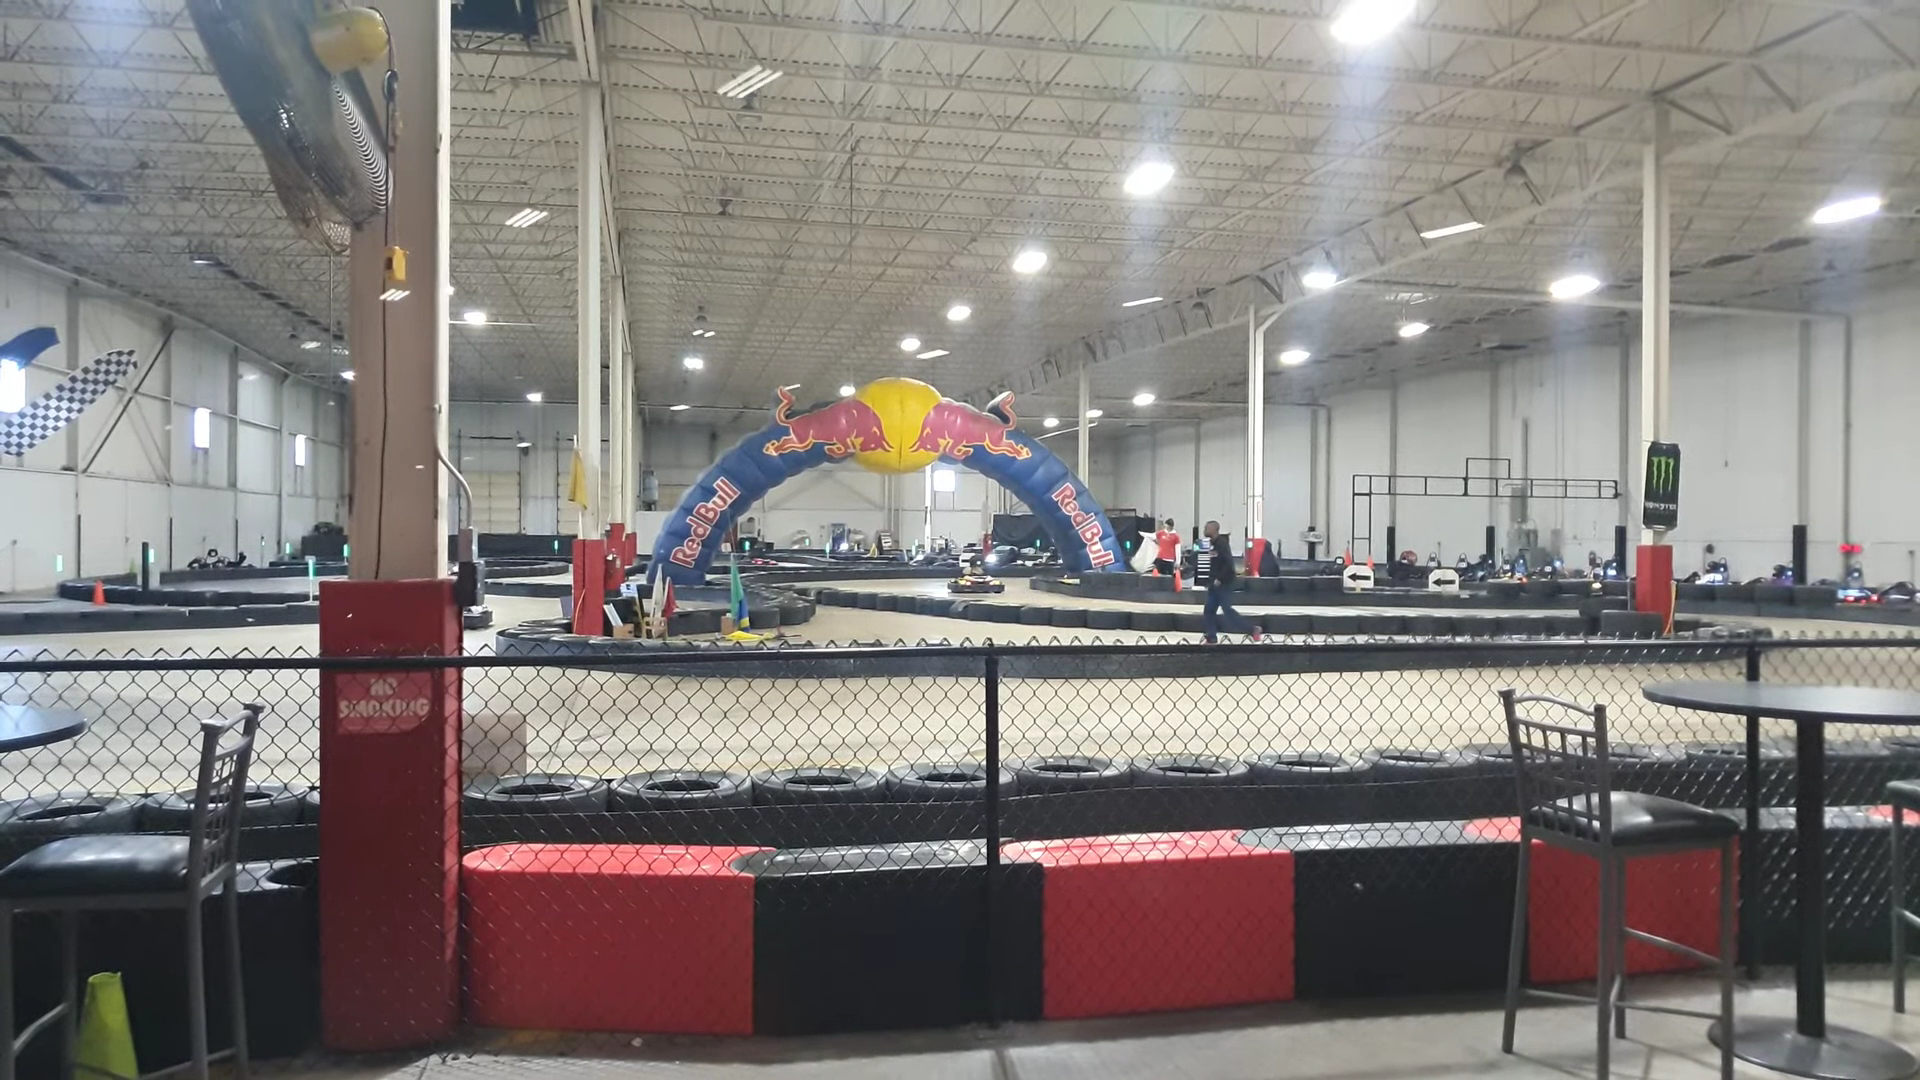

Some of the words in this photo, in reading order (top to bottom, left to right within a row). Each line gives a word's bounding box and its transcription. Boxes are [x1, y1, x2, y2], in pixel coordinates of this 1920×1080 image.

[669, 516, 712, 568] Red
[693, 476, 741, 526] Bull
[1051, 482, 1096, 530] Red
[1078, 520, 1115, 568] Bull
[339, 698, 431, 718] SMOKING
[370, 677, 398, 696] NO
